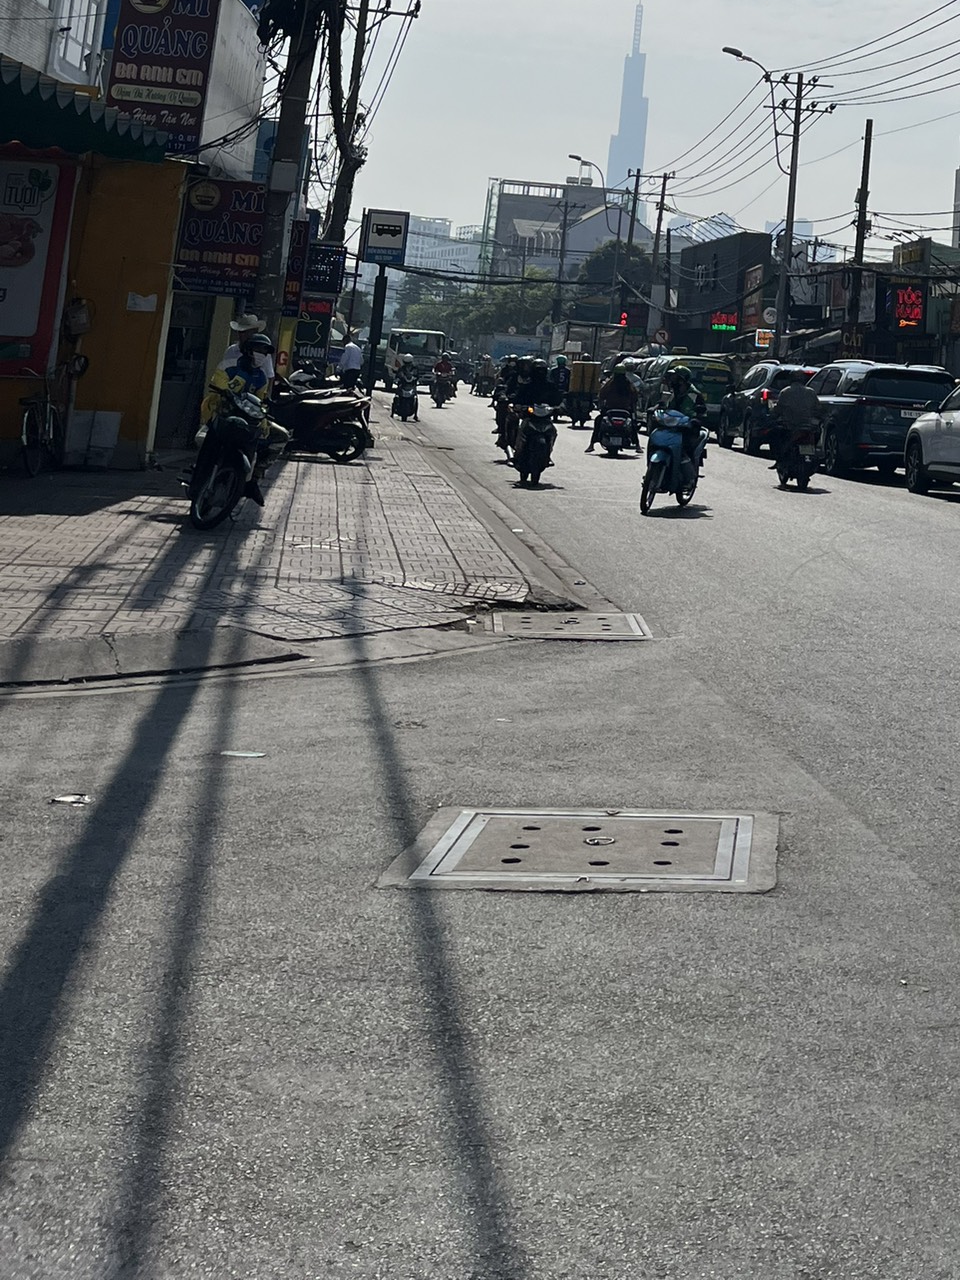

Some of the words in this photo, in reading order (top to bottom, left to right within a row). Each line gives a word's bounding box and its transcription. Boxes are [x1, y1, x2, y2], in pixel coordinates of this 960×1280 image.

[120, 16, 209, 59] QUẢNG
[115, 62, 138, 80] BA
[140, 64, 174, 84] ANH
[230, 185, 266, 214] MÌ
[184, 212, 263, 246] QUẢNG
